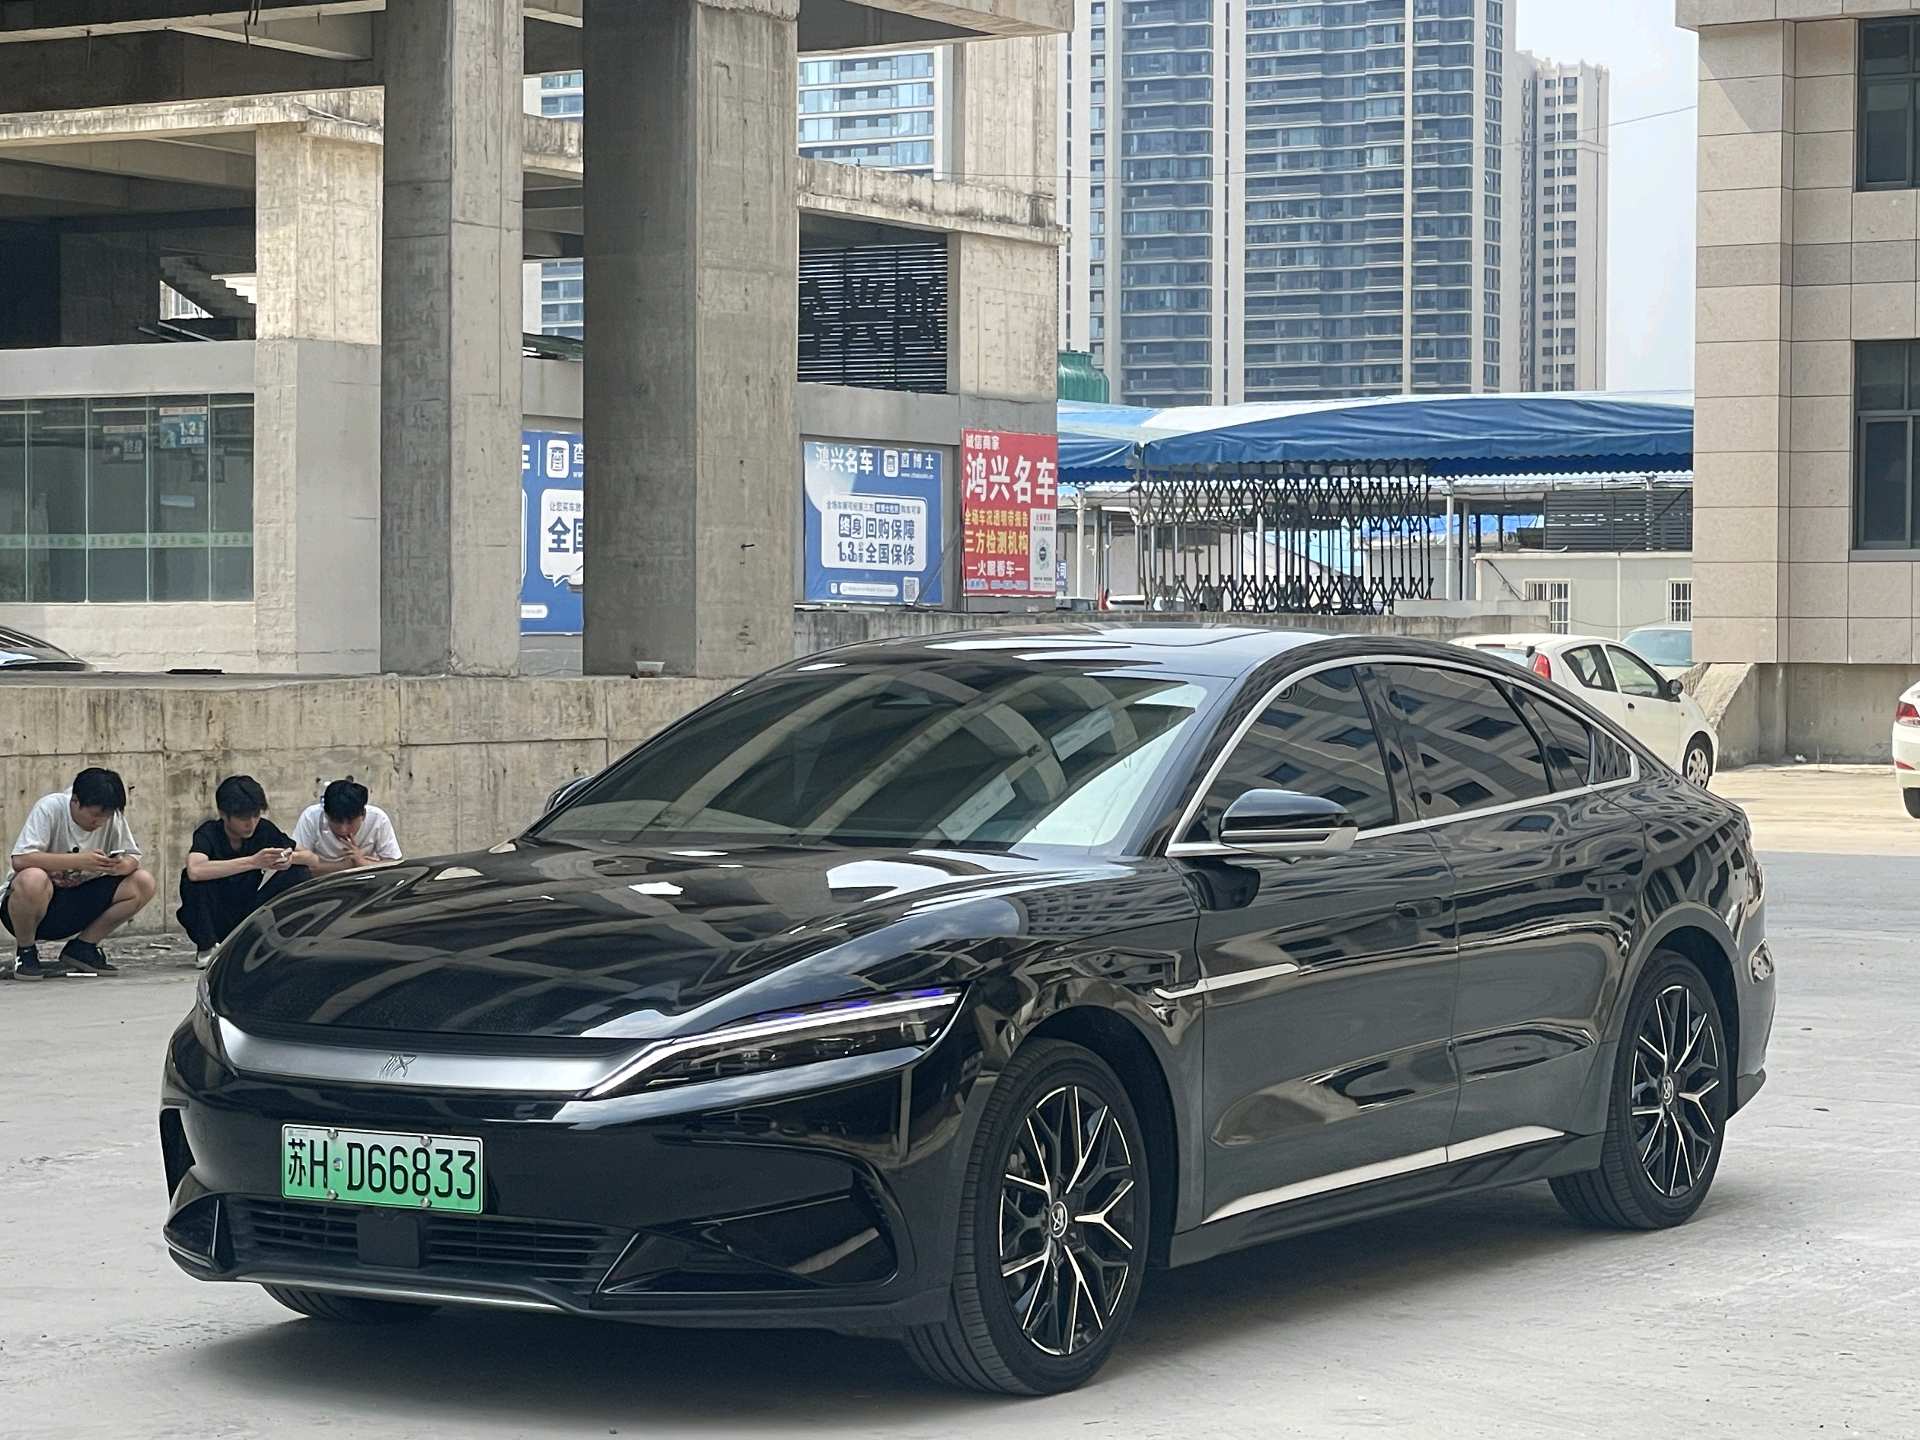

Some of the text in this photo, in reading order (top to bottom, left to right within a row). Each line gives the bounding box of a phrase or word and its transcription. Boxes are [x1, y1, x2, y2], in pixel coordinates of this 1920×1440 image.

[815, 446, 874, 475] 鸿兴名车
[966, 452, 1056, 505] 鸿兴名车
[839, 513, 915, 541] 终身回购保障
[965, 529, 1029, 556] 三方检测机构
